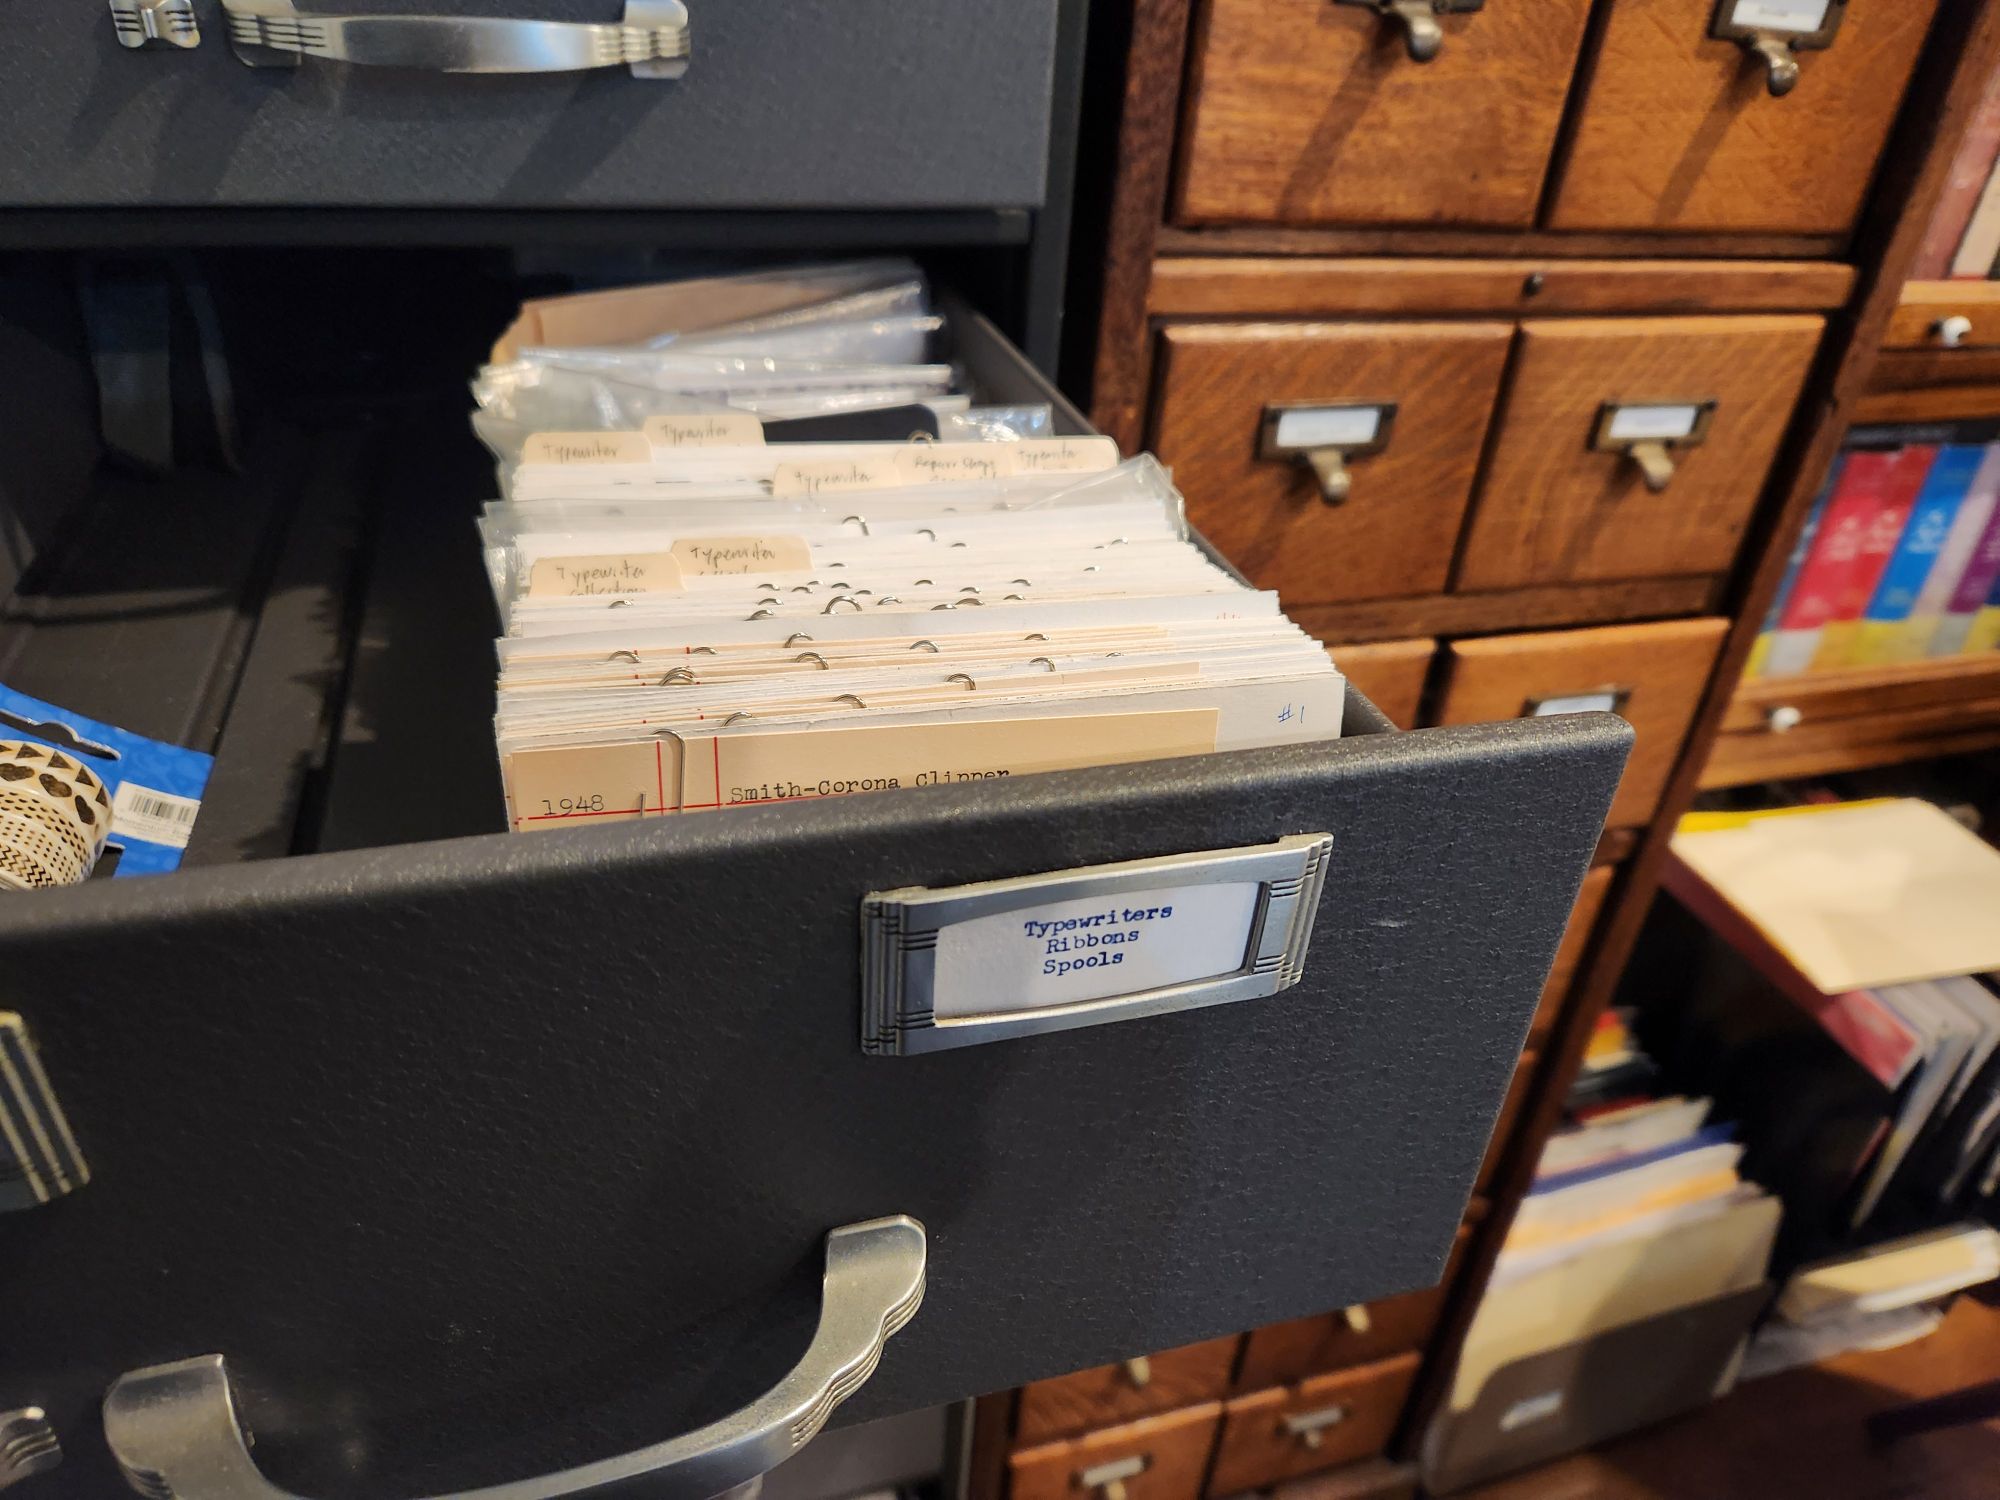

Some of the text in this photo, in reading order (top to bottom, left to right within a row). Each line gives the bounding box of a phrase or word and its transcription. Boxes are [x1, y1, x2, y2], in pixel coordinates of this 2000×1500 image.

[689, 540, 776, 570] Typewriter
[555, 559, 647, 588] Typewriter
[1277, 703, 1305, 724] #1
[731, 774, 901, 804] Smith-Corona
[541, 794, 605, 817] 1948
[1024, 906, 1173, 938] Typewriters
[1045, 930, 1140, 954] Ribbons
[1043, 951, 1124, 976] Spools
